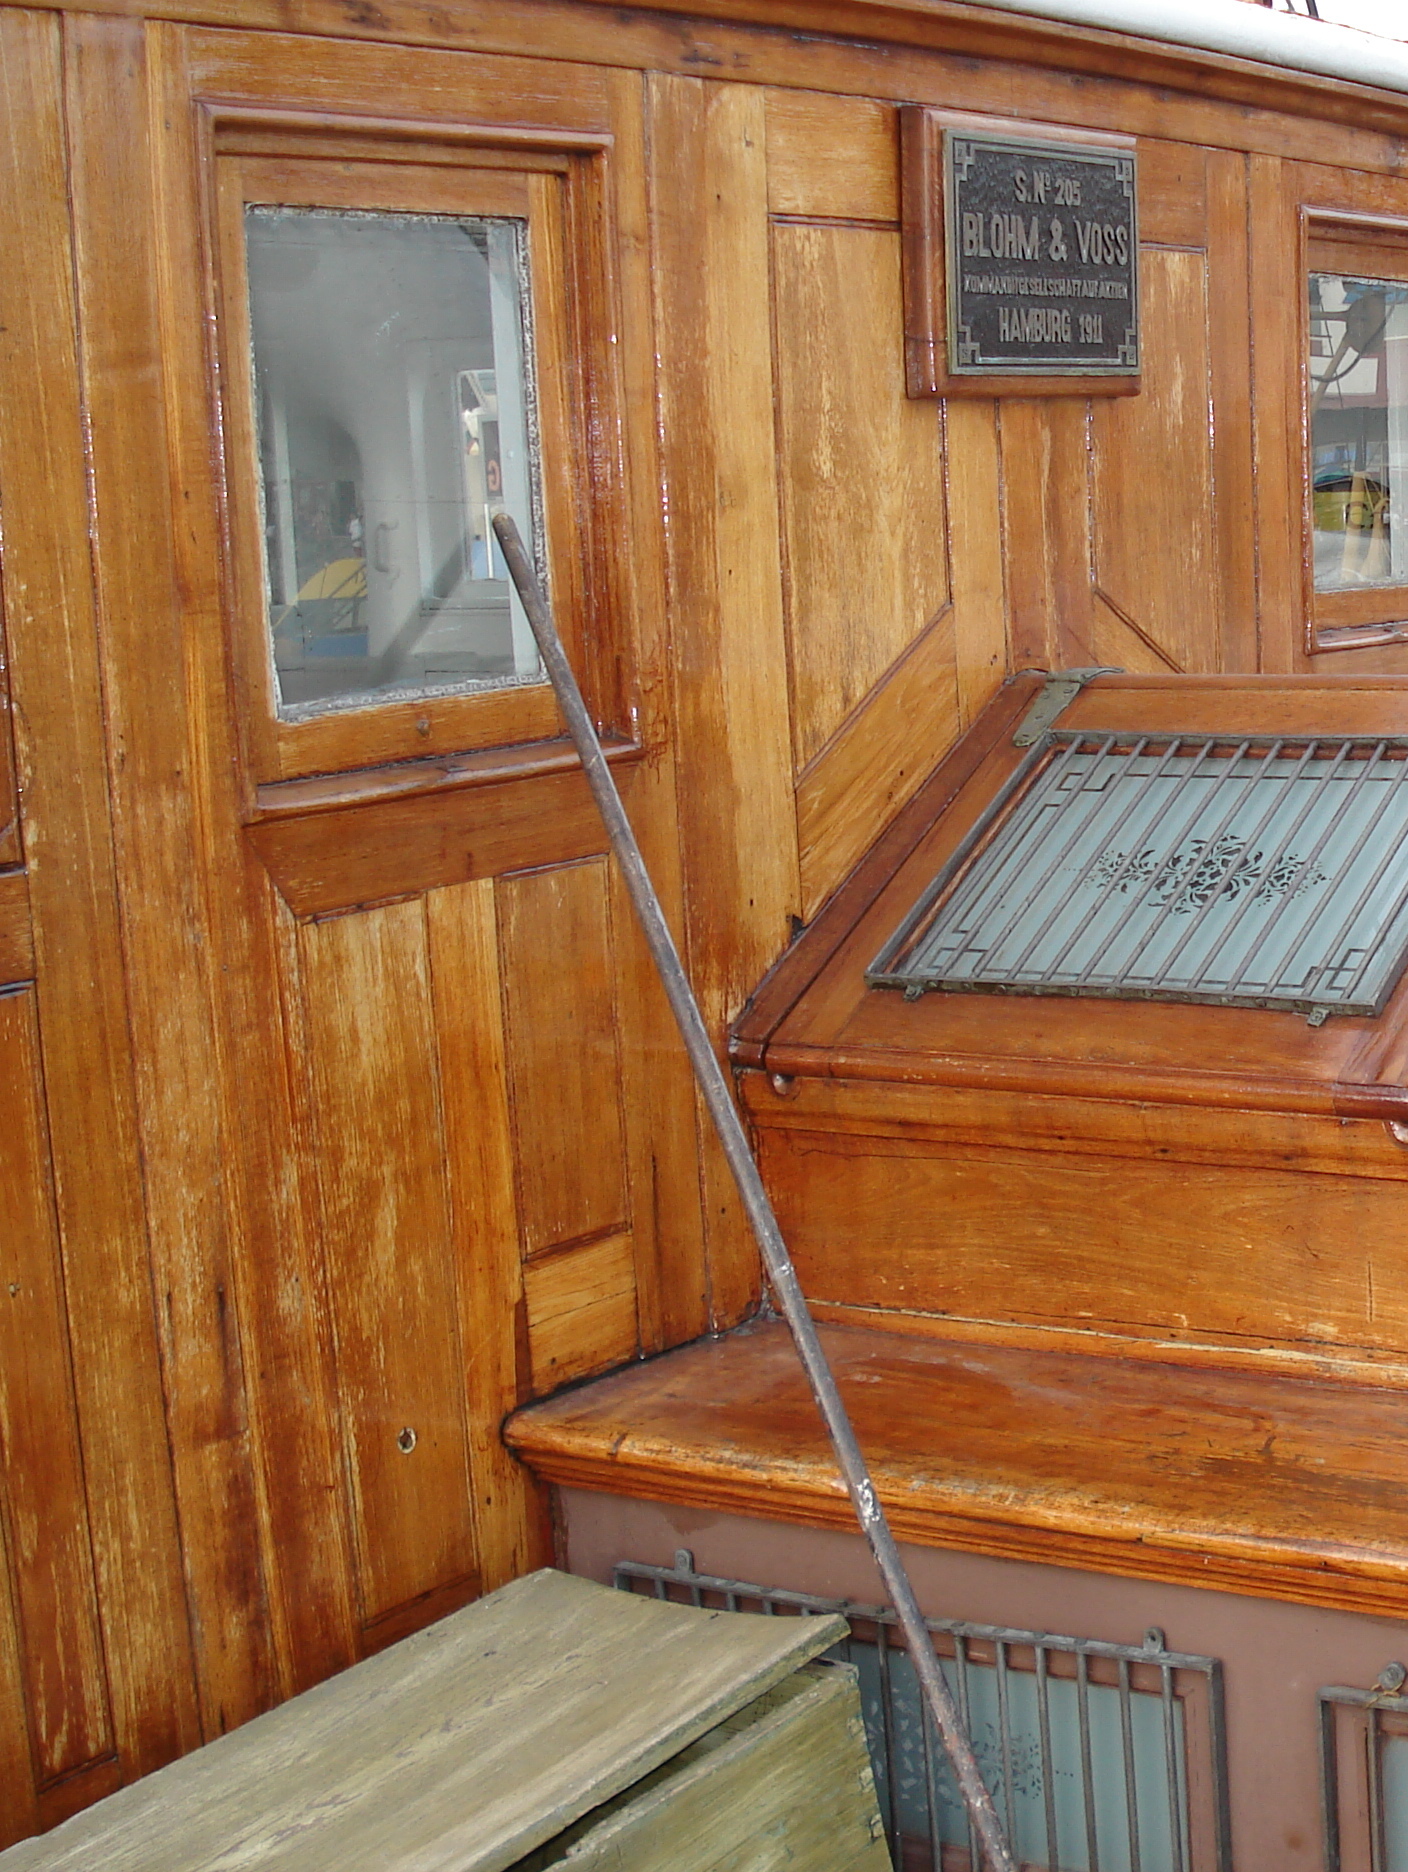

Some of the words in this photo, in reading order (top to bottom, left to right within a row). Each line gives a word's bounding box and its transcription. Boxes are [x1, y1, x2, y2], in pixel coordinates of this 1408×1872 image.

[1054, 178, 1082, 206] 205
[963, 212, 1040, 260] BLOHM
[1049, 217, 1067, 262] &
[1073, 219, 1128, 266] VOSS
[999, 307, 1071, 343] HAMBURG
[1079, 313, 1103, 344] 1911
